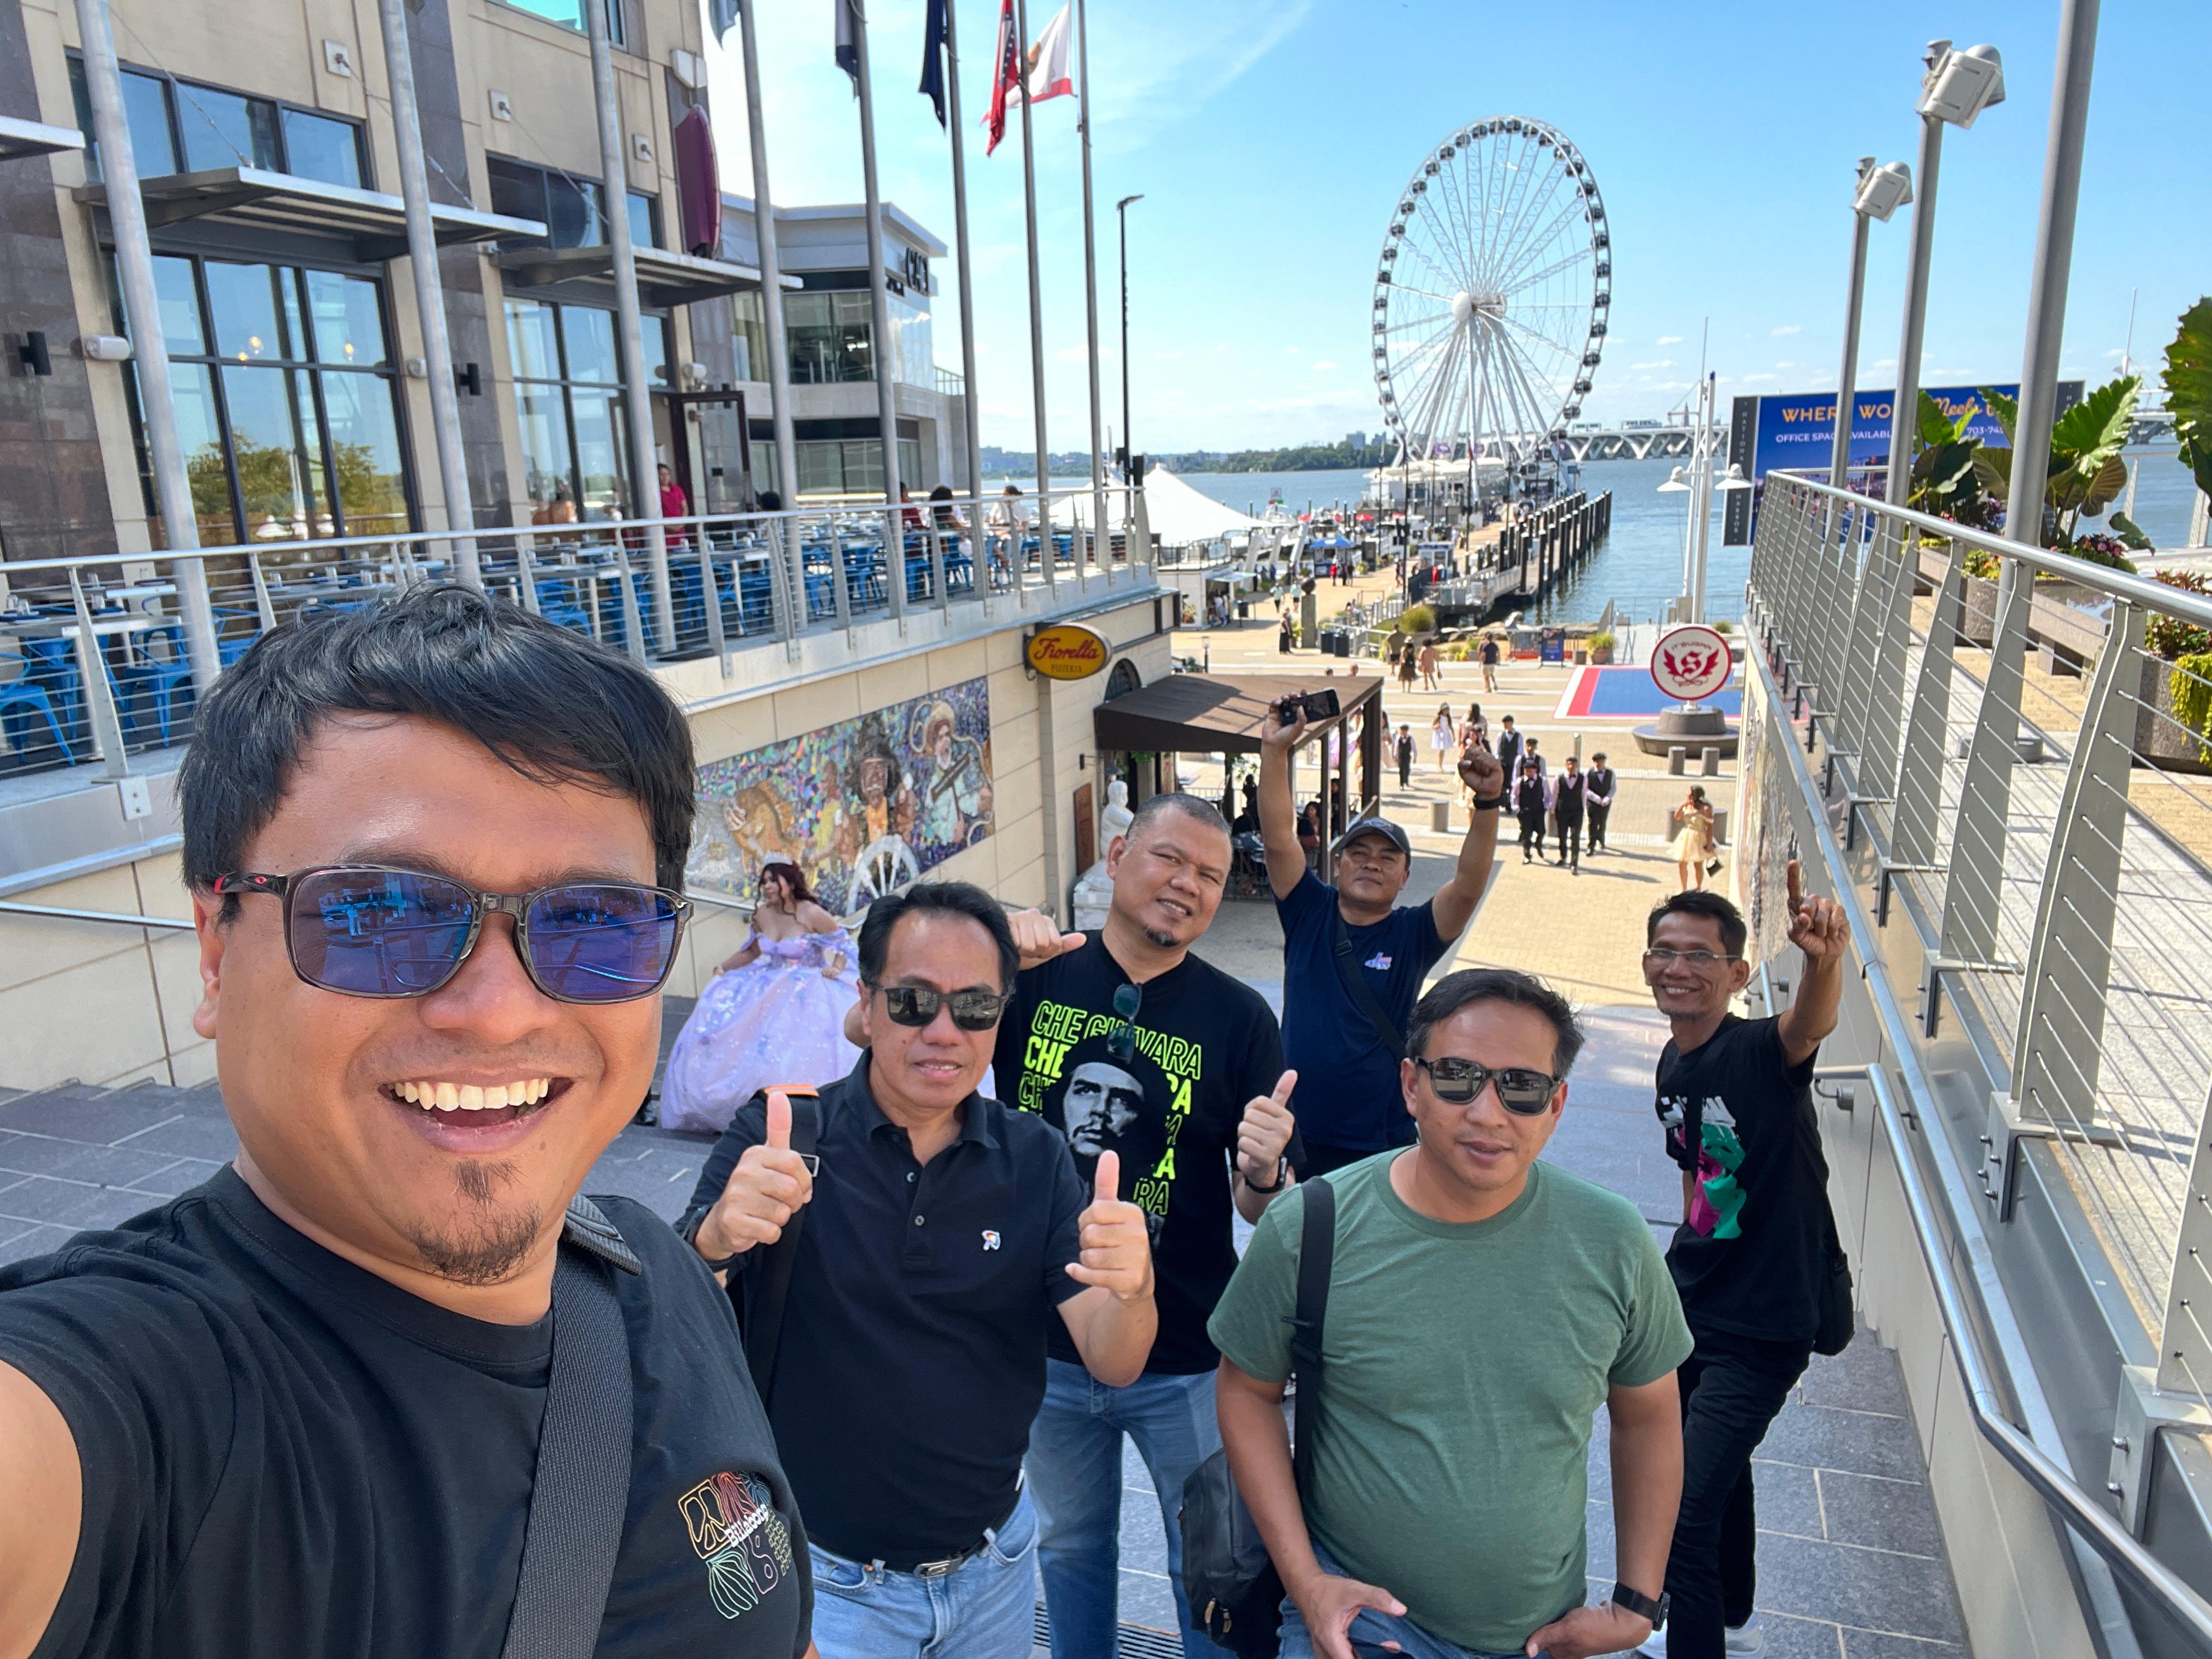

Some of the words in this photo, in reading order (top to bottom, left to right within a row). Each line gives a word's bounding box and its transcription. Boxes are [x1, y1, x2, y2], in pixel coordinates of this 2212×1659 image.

[1782, 407, 1837, 423] WHER
[1859, 403, 1892, 419] WO
[1739, 411, 1748, 462] NATIONA
[1775, 433, 1810, 444] OFFICE
[1812, 432, 1835, 442] SPAC
[1849, 430, 1892, 441] VAILABL
[1033, 637, 1100, 661] Fiorella
[1031, 1000, 1088, 1045] CHE
[1024, 1035, 1072, 1079] CHE
[724, 1503, 770, 1548] Billabong
